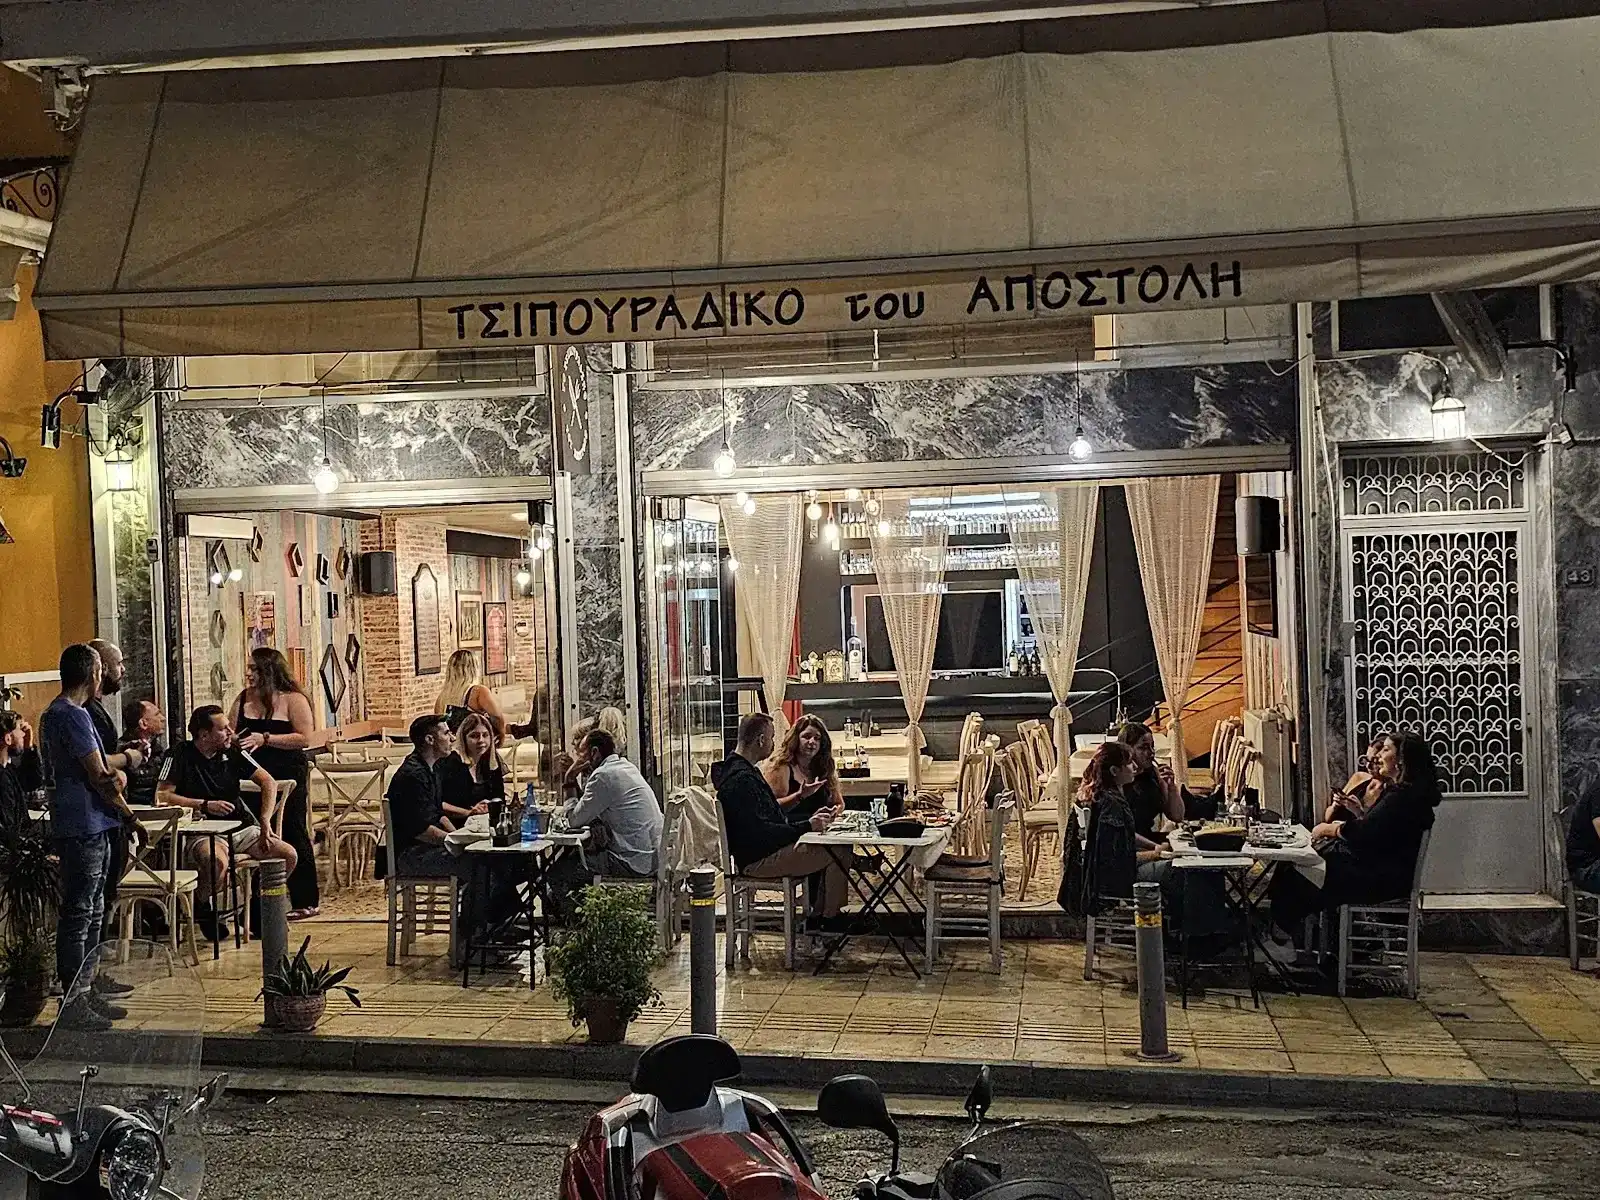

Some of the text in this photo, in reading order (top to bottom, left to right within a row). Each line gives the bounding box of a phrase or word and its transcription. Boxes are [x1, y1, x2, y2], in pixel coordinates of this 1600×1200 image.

[447, 260, 1242, 340] ΤΣΙΠΟΥΡΑΔΙΚΟ του ΑΠΟΣΤΟΛΗ
